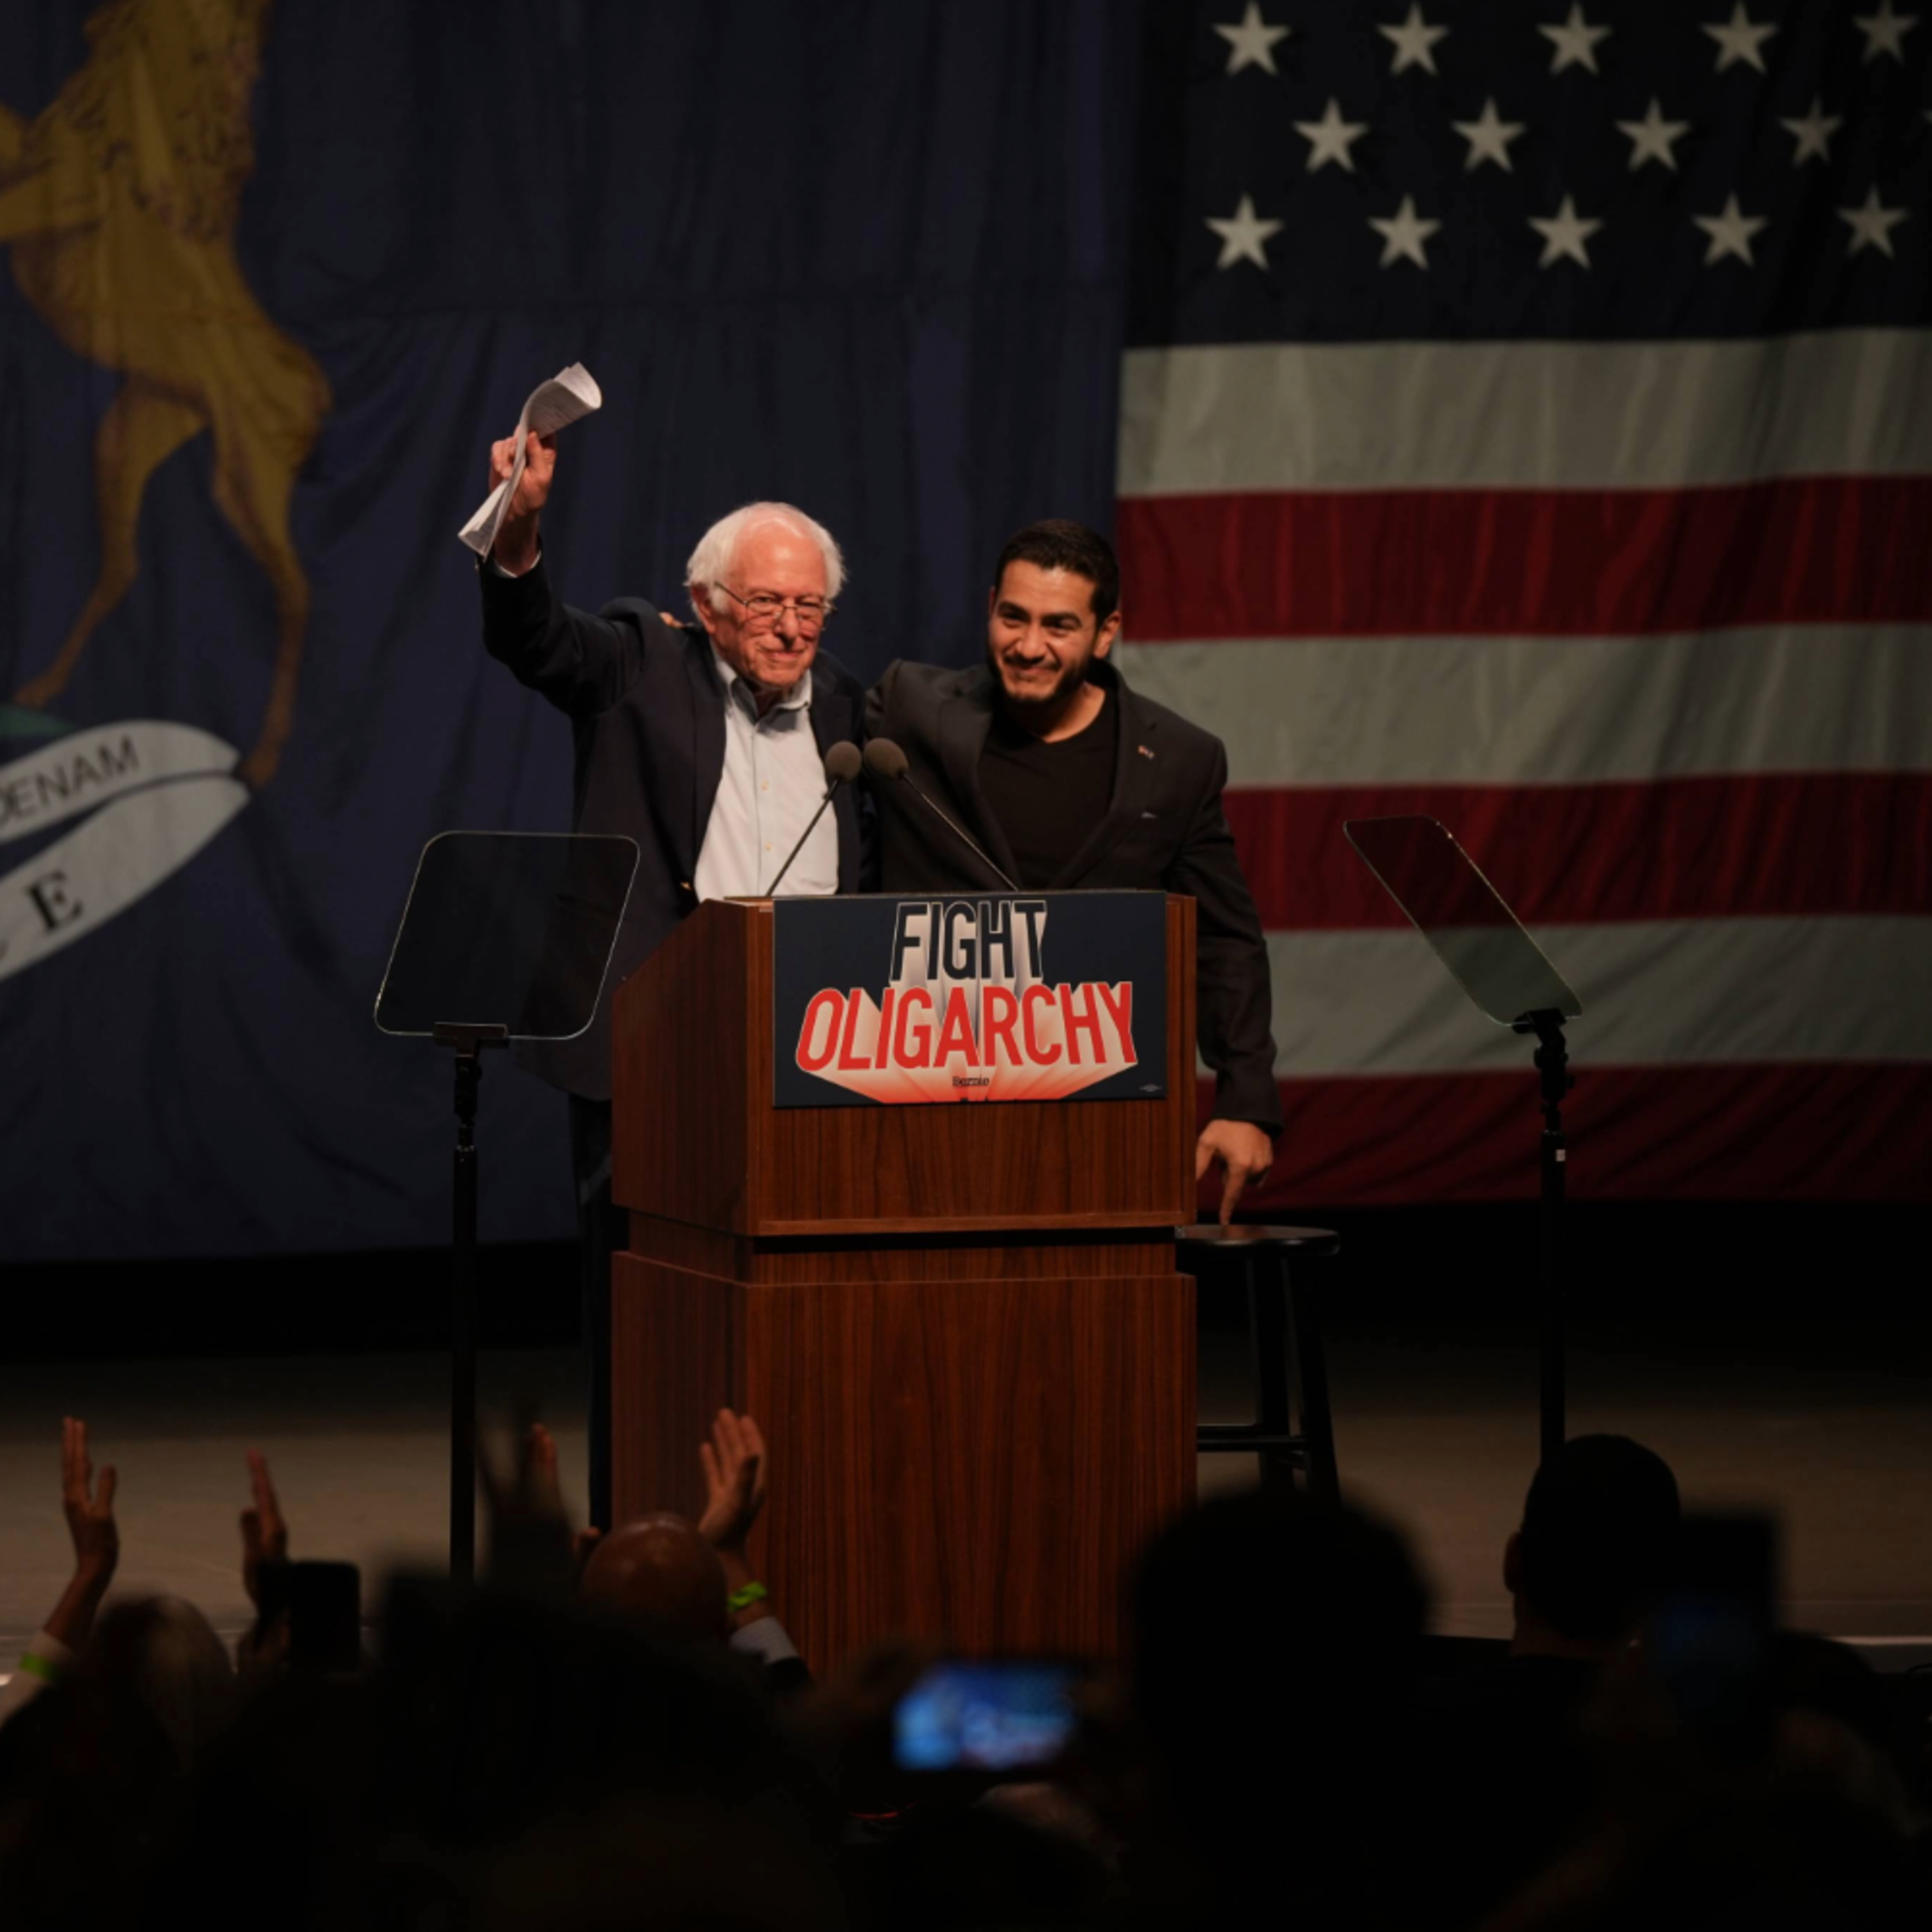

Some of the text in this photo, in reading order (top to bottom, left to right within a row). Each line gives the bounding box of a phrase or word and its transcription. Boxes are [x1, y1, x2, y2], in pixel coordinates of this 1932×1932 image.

[889, 900, 1047, 982] FIGHT
[795, 981, 1138, 1072] OLIGARCHY
[952, 1075, 990, 1087] Bernie
